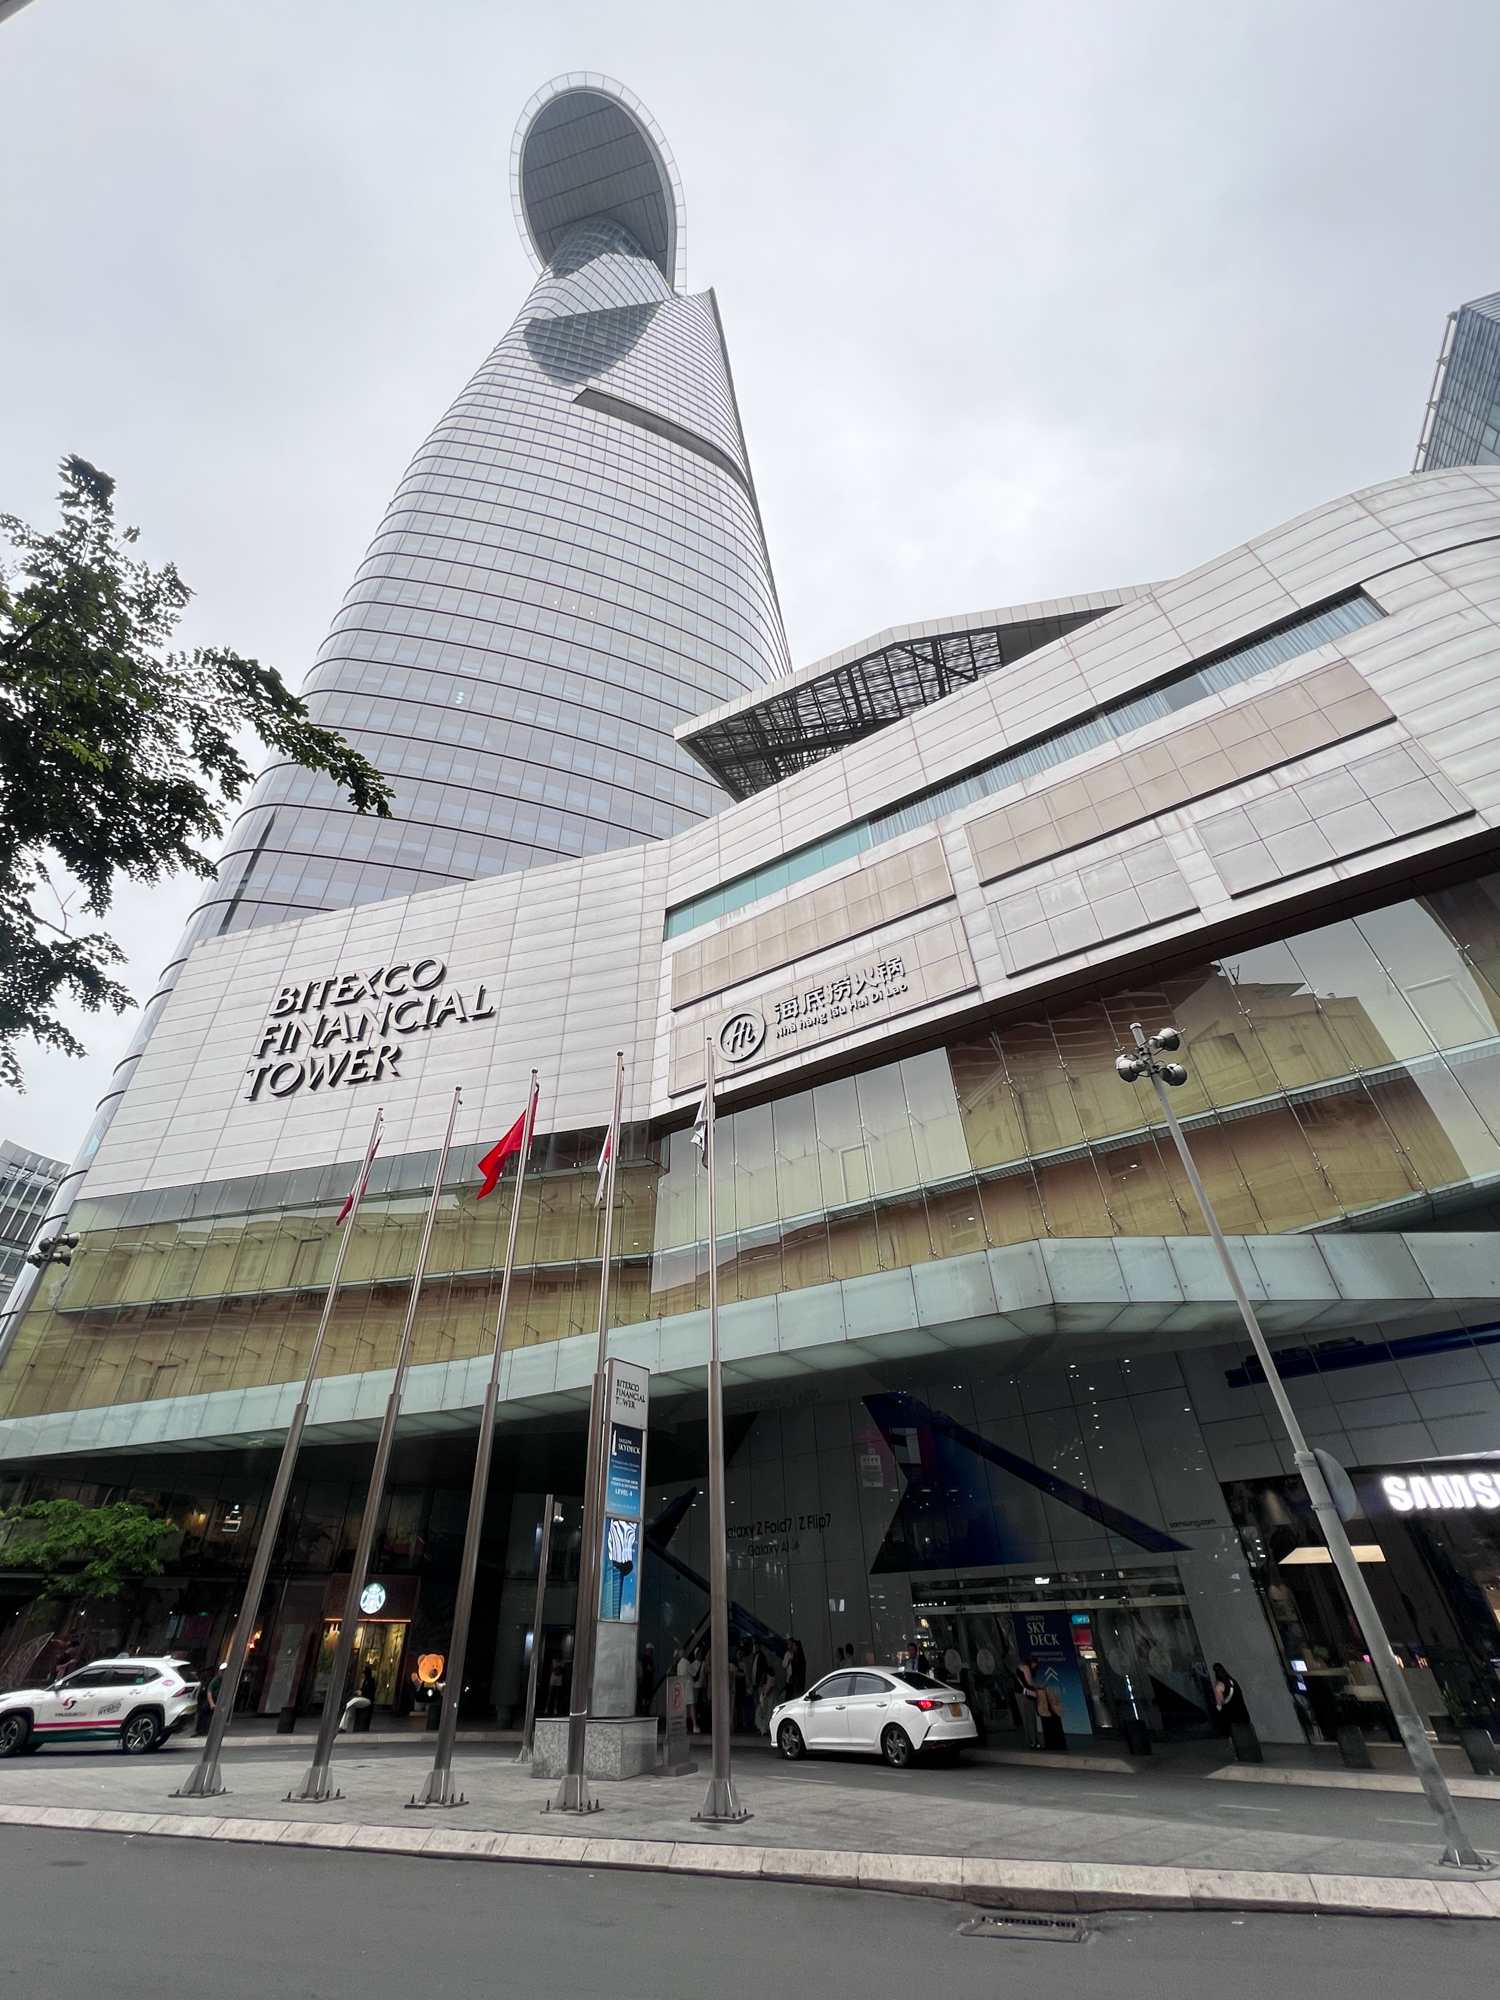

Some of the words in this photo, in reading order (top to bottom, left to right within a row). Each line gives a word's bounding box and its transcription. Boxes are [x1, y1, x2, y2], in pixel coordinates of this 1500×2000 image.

[269, 957, 446, 1017] BITEXCO
[886, 983, 909, 999] Lao
[253, 984, 496, 1058] FINANCIAL
[243, 1042, 402, 1101] TOWER
[616, 1379, 640, 1392] BITEXCO
[616, 1388, 645, 1403] FINANCIAL
[615, 1397, 636, 1409] TOWER
[618, 1443, 641, 1455] SKYDECK
[615, 1488, 629, 1497] LEVEL
[727, 1524, 755, 1539] alaxy
[757, 1522, 763, 1535] Z
[764, 1518, 792, 1534] Fold7
[799, 1517, 805, 1531] Z
[808, 1513, 831, 1533] Flip7
[1169, 1518, 1217, 1528] samsung.com
[748, 1543, 780, 1558] Galaxy
[781, 1541, 789, 1553] AI
[1025, 1614, 1045, 1622] SAIGON
[1026, 1621, 1046, 1634] SKY
[1030, 1633, 1060, 1646] DECK
